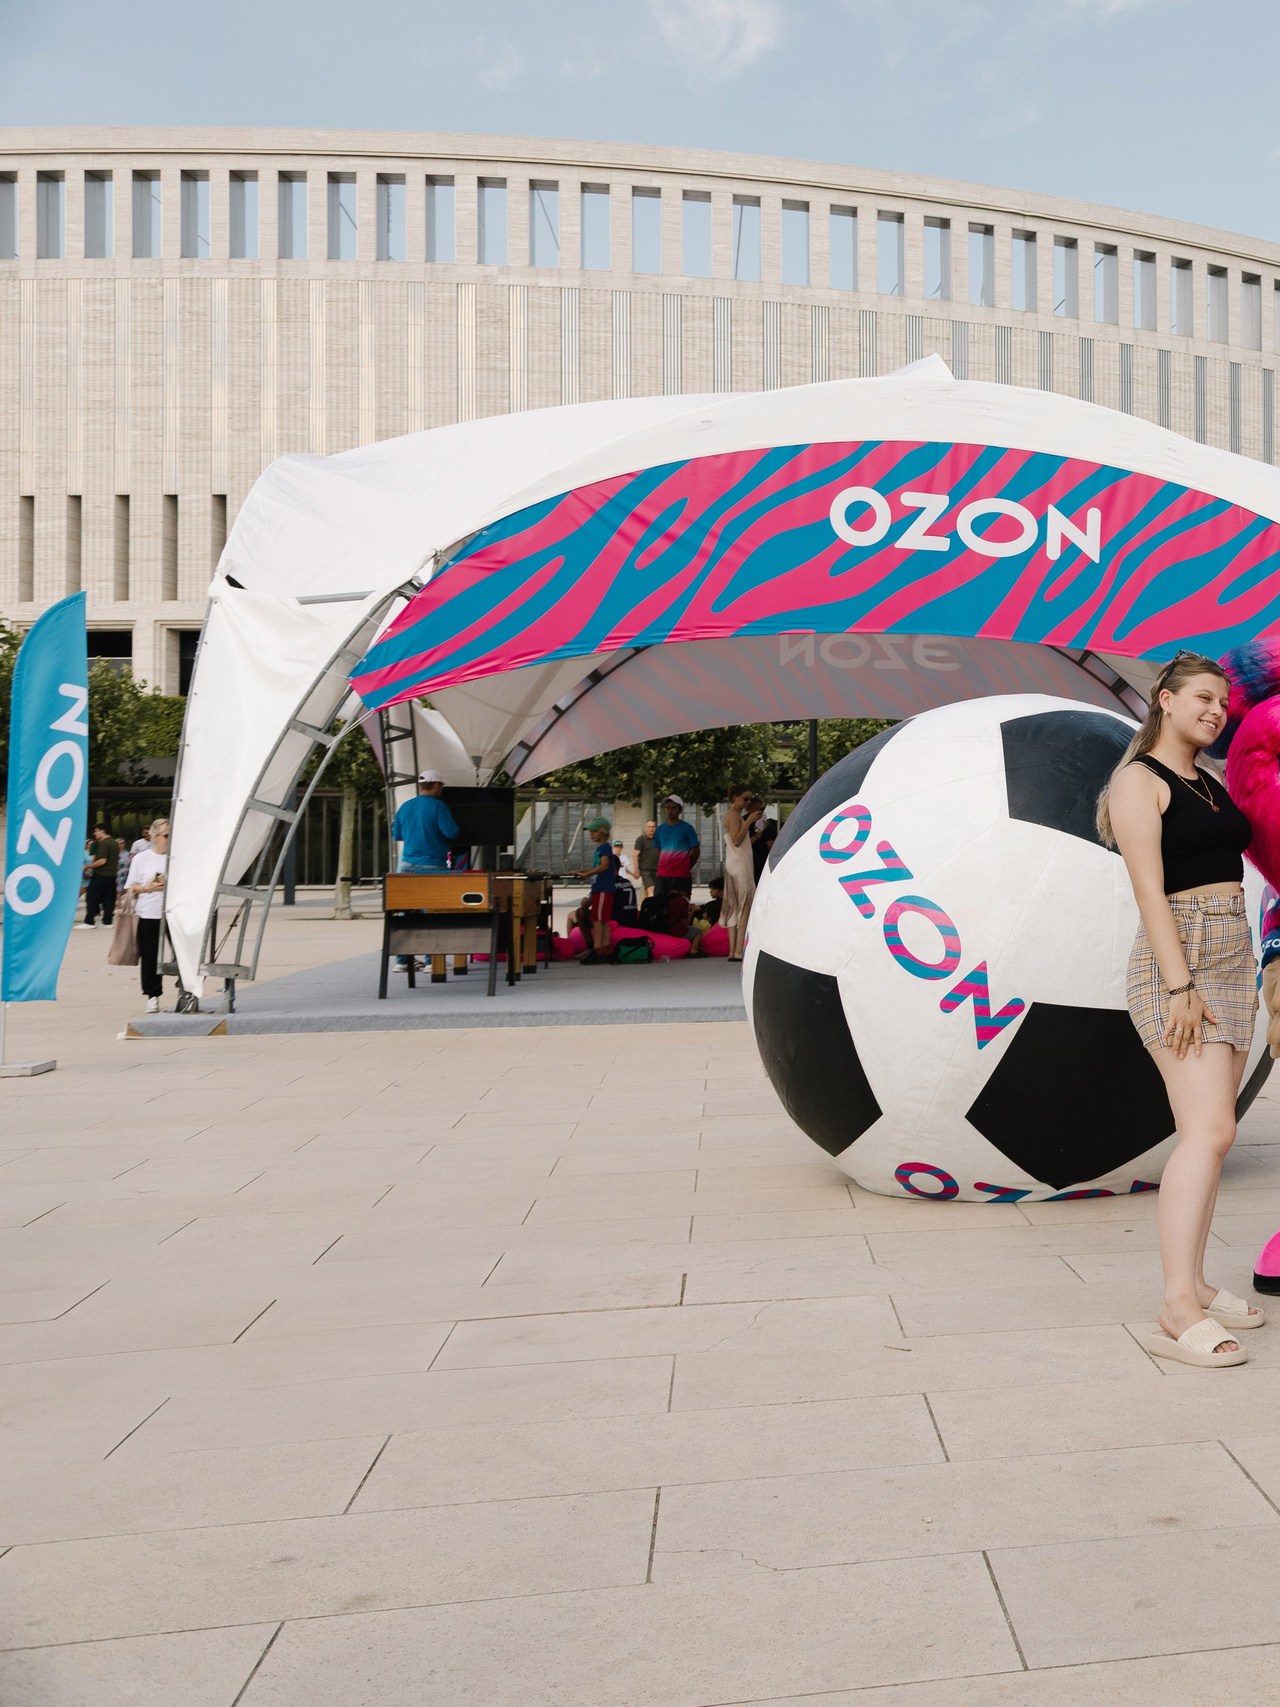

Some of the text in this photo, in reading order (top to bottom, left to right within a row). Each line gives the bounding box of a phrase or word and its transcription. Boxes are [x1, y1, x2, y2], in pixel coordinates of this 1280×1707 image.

[829, 486, 1102, 564] OZON
[5, 683, 88, 916] OZON
[819, 804, 1026, 1050] OZON
